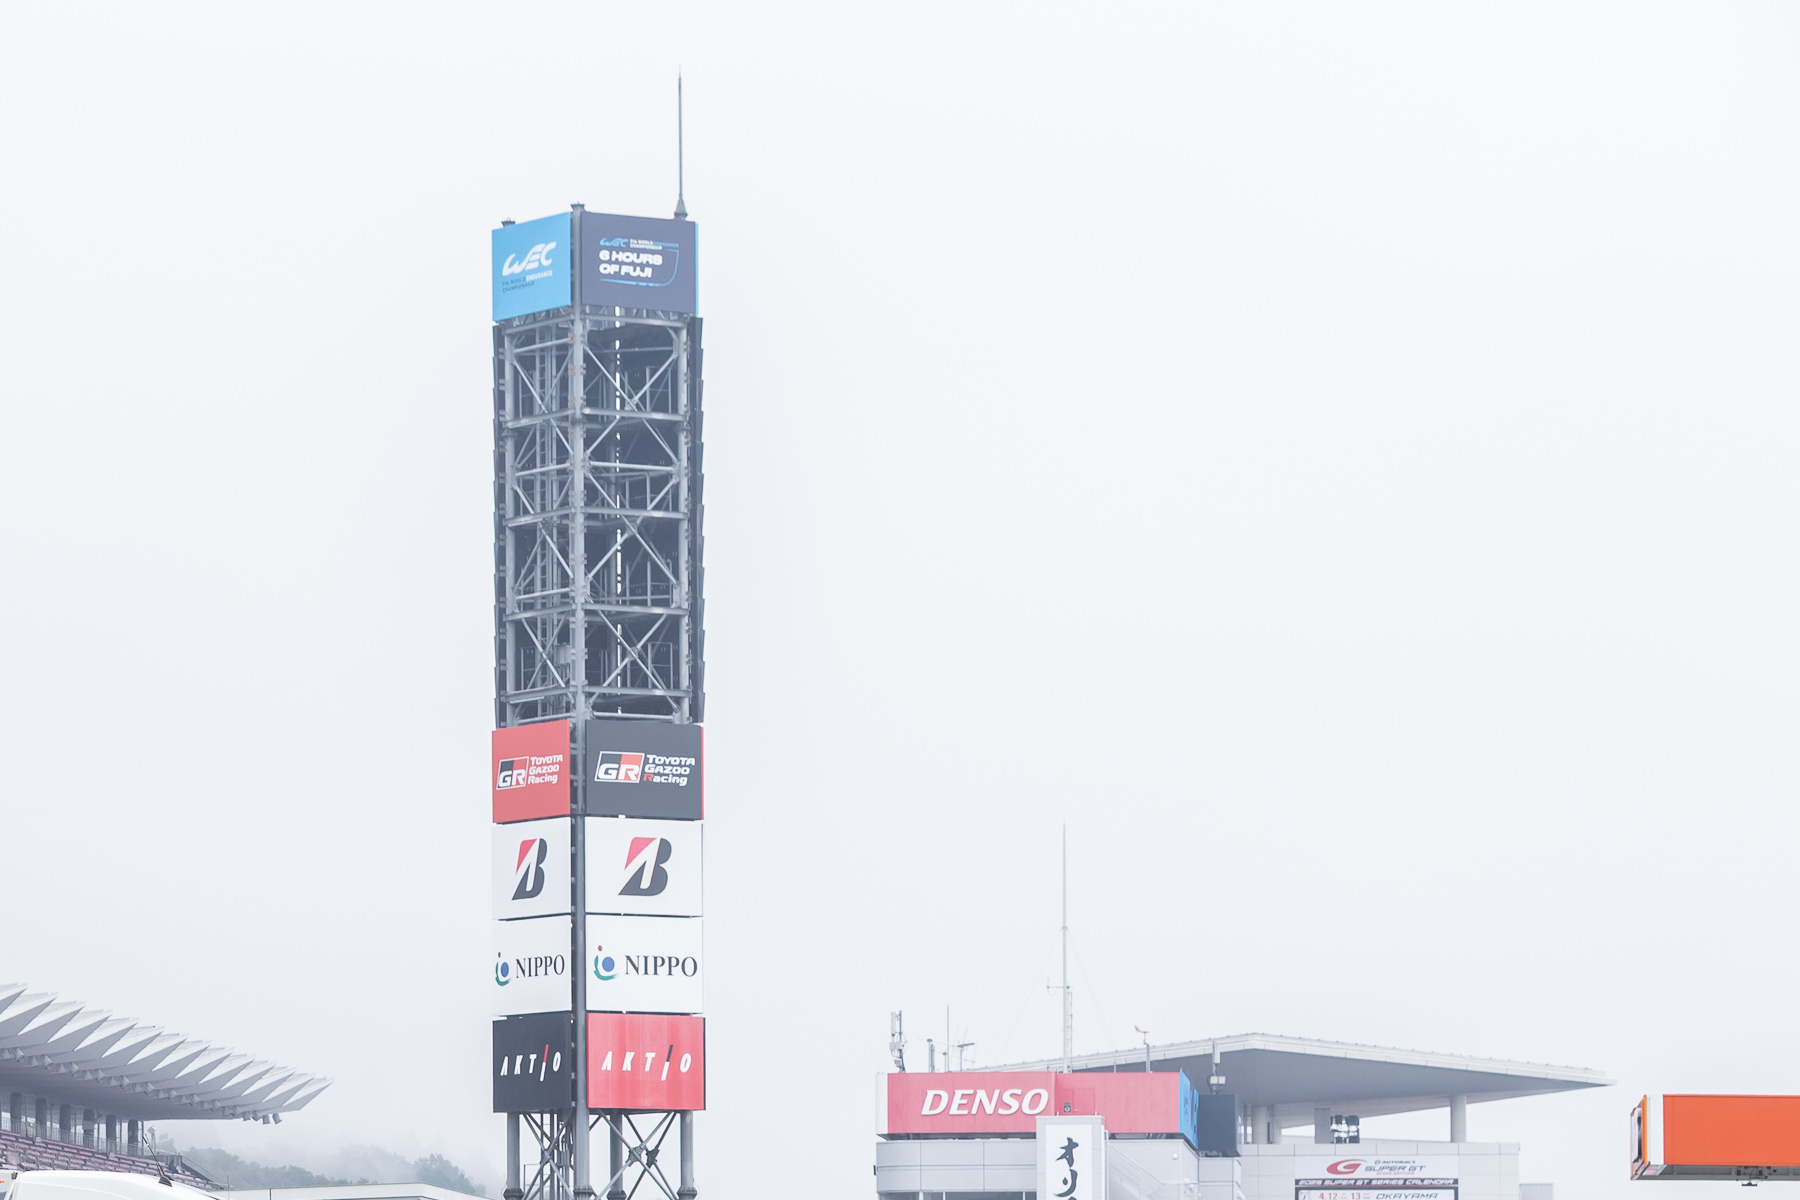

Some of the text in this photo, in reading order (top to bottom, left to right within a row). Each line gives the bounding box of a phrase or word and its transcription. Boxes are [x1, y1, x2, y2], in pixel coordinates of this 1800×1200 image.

[502, 241, 557, 277] WEC
[599, 249, 663, 266] 6 HOURS
[599, 263, 652, 278] OF FUJI
[531, 754, 563, 766] TOYOTA
[646, 754, 696, 766] TOYOTA
[498, 769, 526, 787] GR
[529, 764, 560, 775] GAZOO
[598, 763, 641, 782] GR
[644, 764, 691, 775] GAZOO
[528, 773, 558, 785] Racing
[643, 773, 688, 787] Racing
[515, 954, 565, 979] NIPPO
[624, 954, 698, 977] NIPPO
[500, 1044, 562, 1082] AKTIO
[601, 1044, 692, 1081] AKTIO
[920, 1088, 1049, 1116] DENSO
